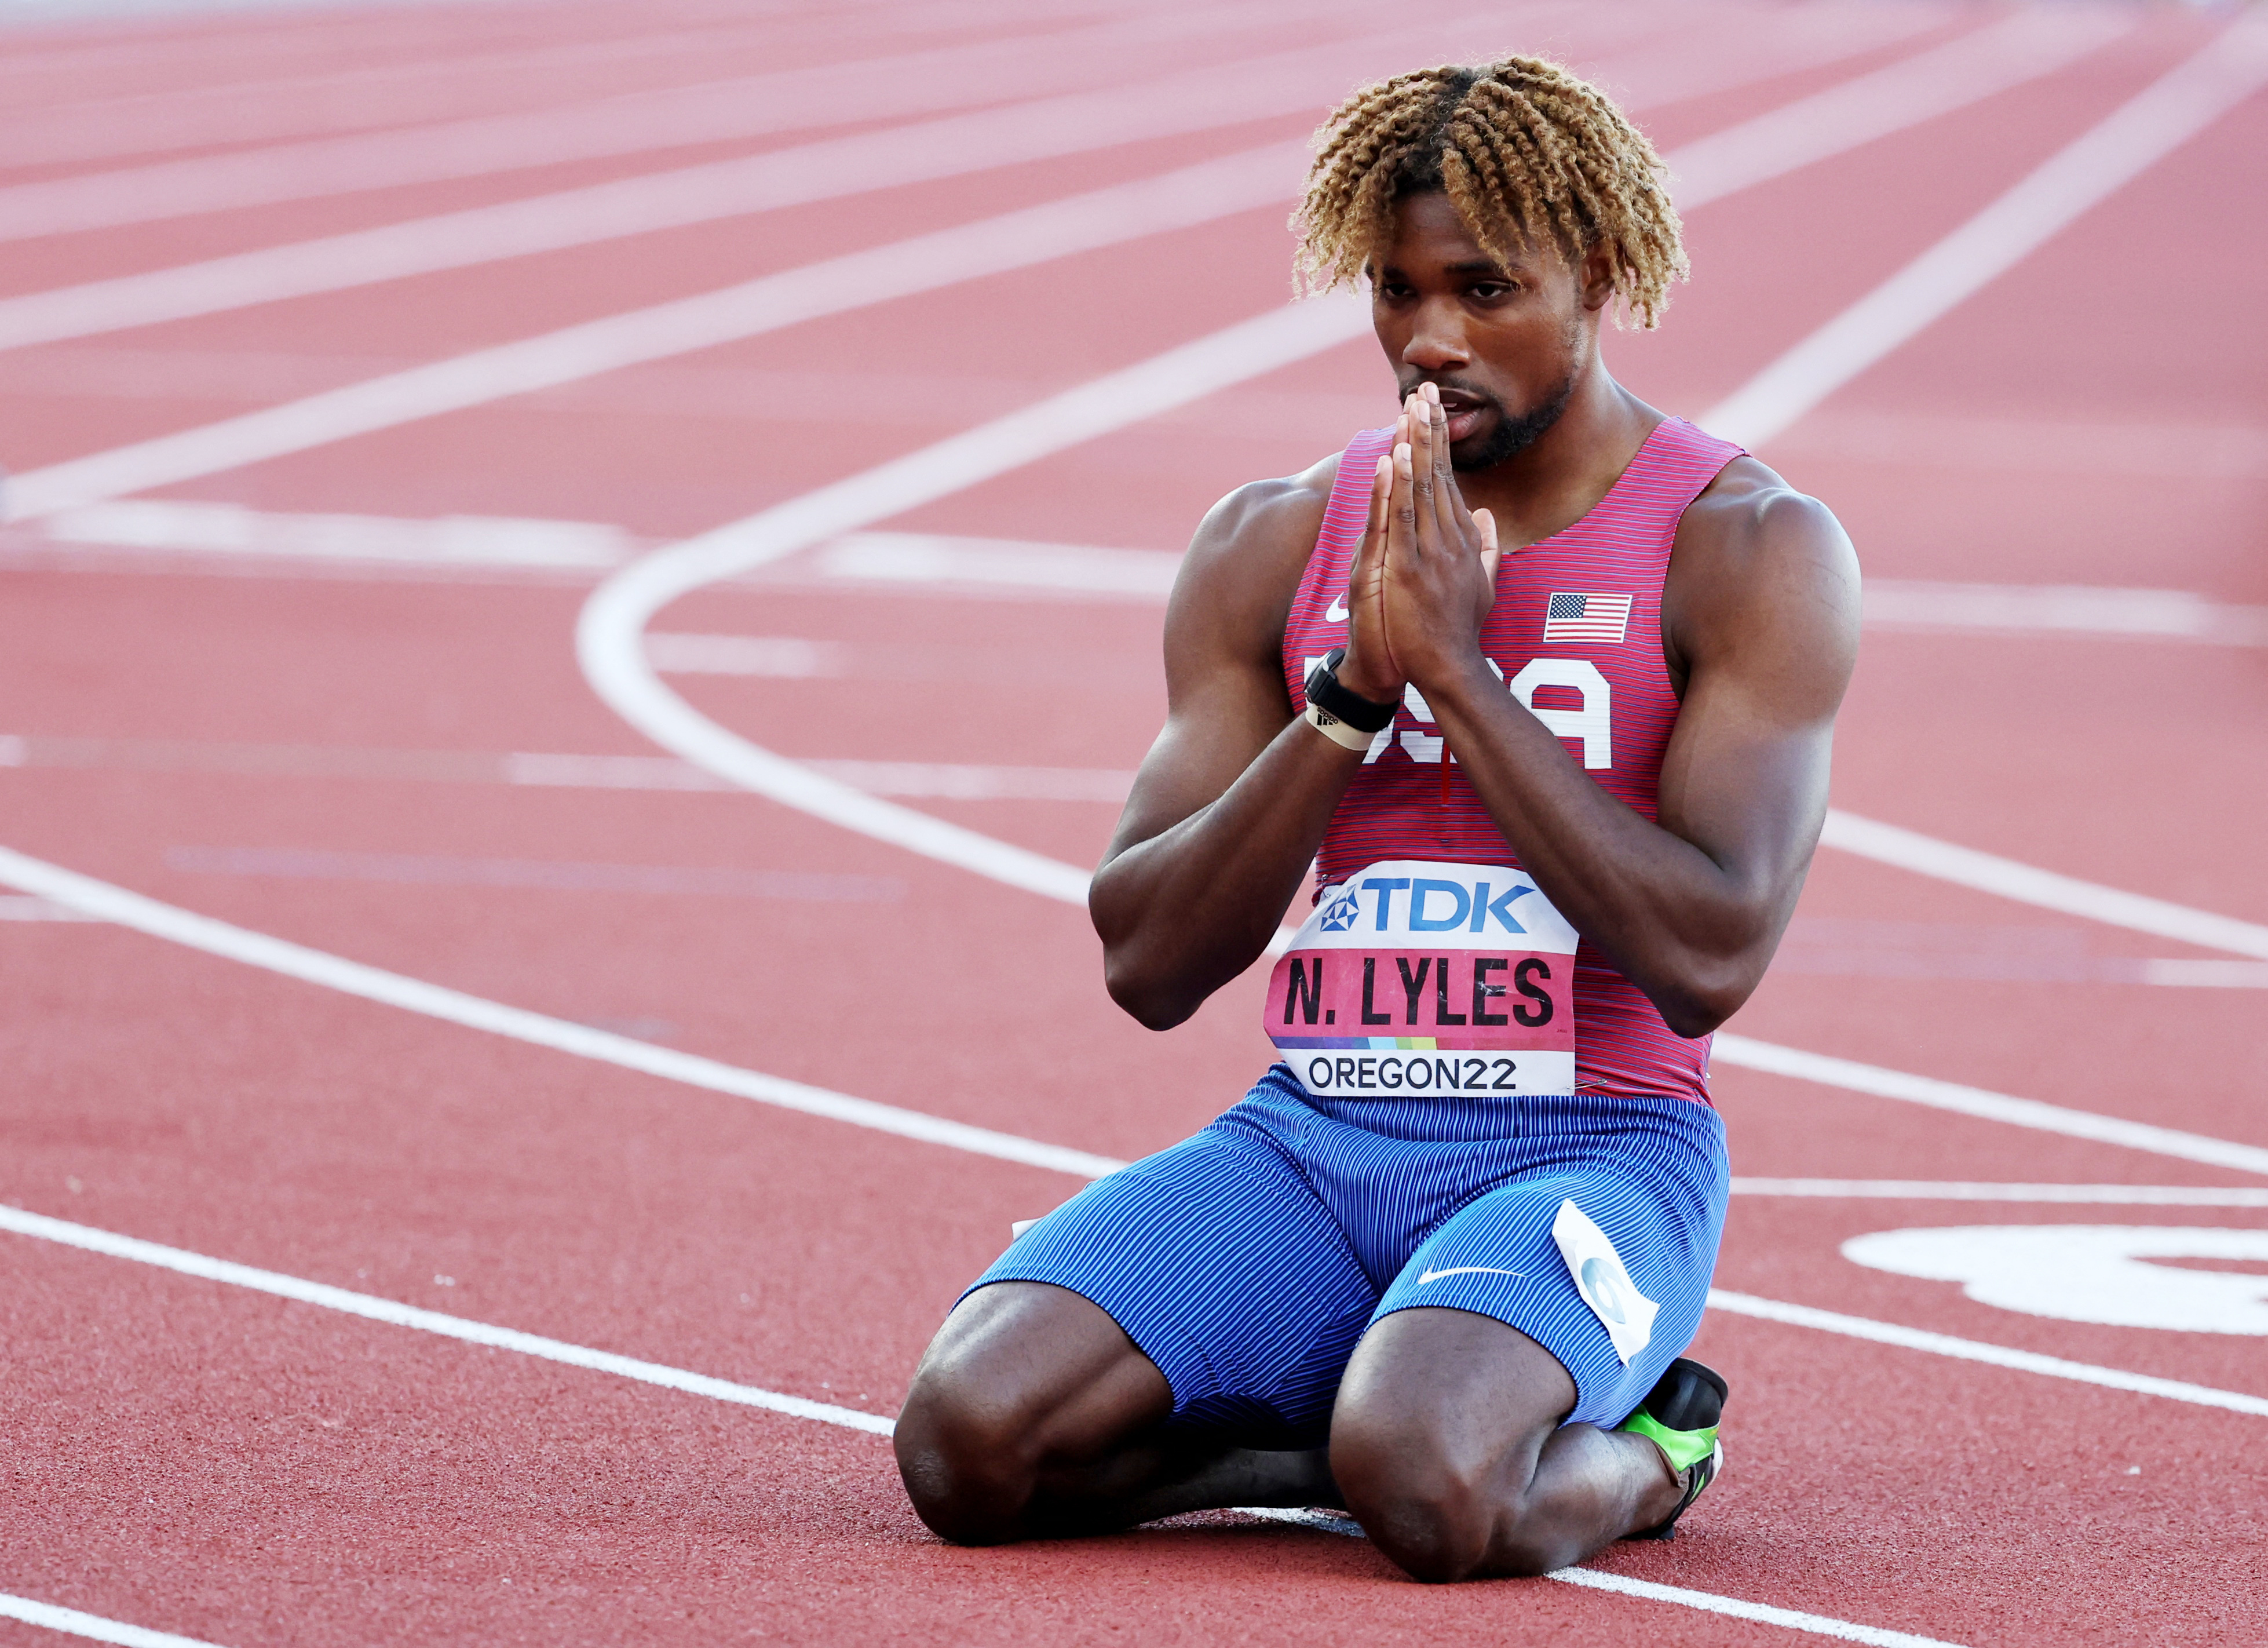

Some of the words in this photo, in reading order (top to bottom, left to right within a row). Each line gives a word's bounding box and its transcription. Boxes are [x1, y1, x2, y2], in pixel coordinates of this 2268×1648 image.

[1361, 877, 1536, 934] TDK
[1283, 957, 1335, 1025] N.
[1360, 957, 1554, 1027] LYLES
[1308, 1057, 1517, 1090] OREGON22
